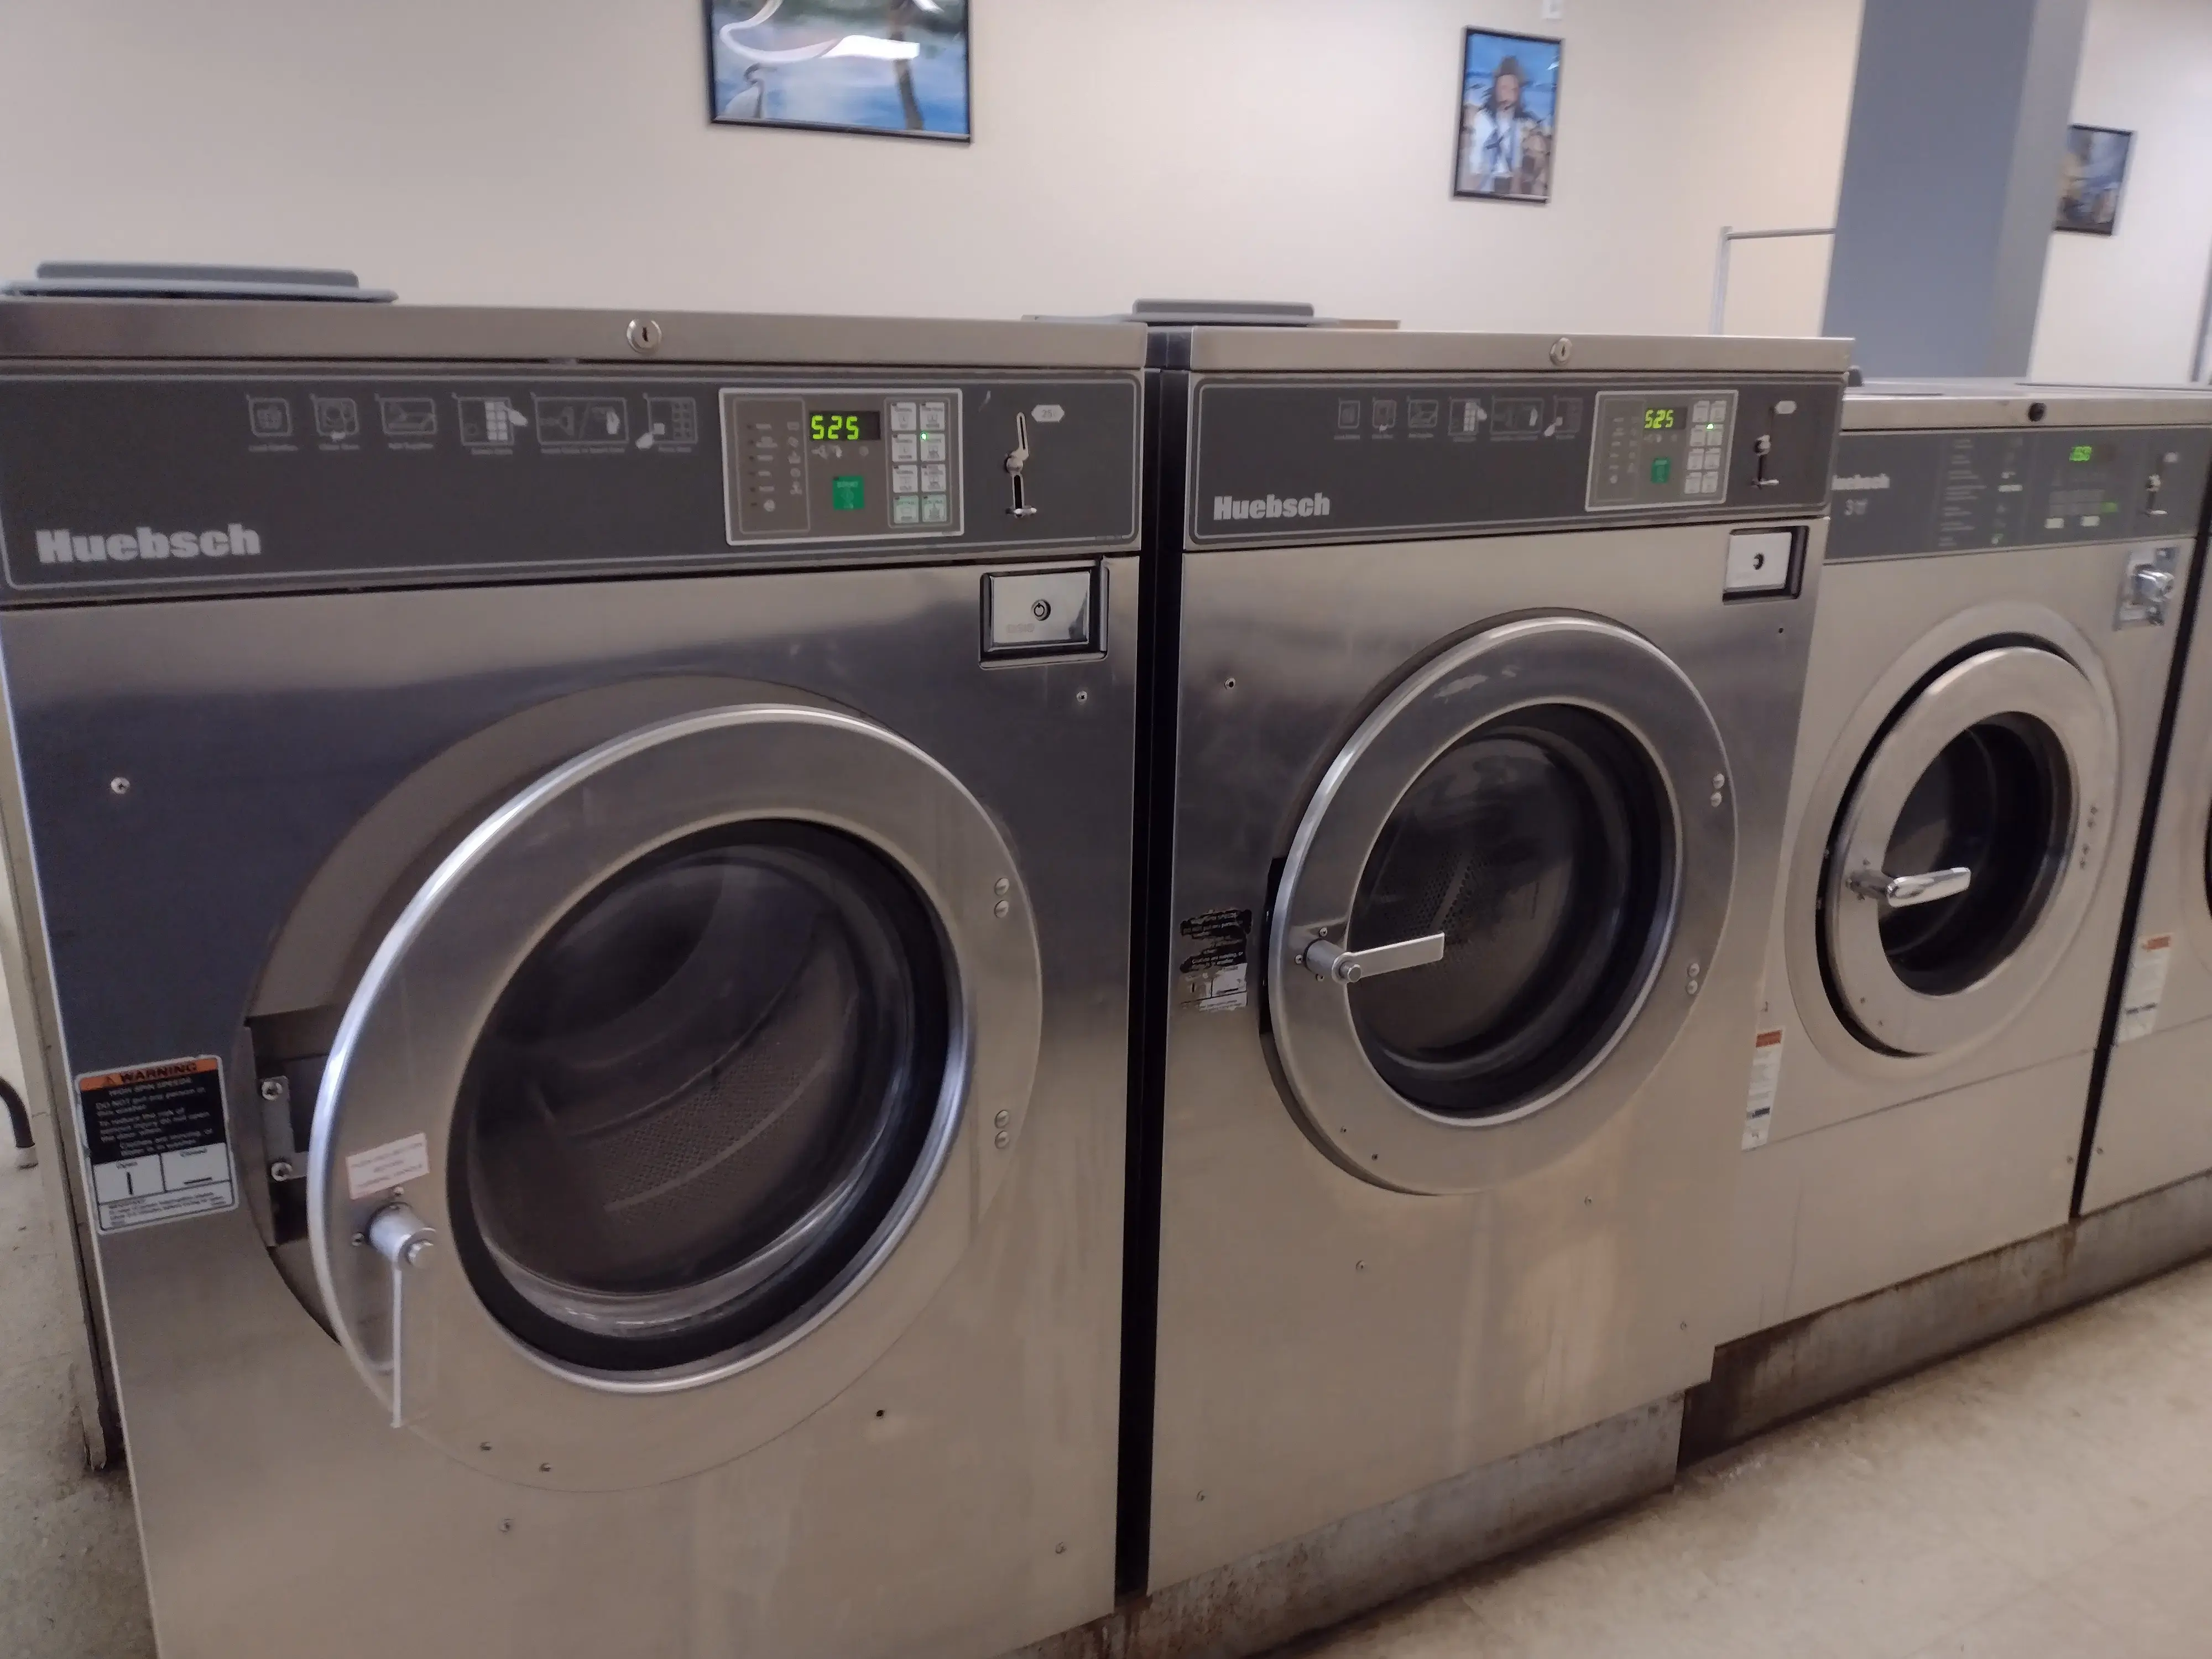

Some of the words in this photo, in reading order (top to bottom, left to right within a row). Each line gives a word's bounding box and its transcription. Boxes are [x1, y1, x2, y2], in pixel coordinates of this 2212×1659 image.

[811, 415, 859, 440] 525
[1645, 409, 1674, 429] 525
[1213, 492, 1331, 520] Huebsch
[35, 523, 261, 564] Huebsch
[119, 1061, 198, 1084] WARNING
